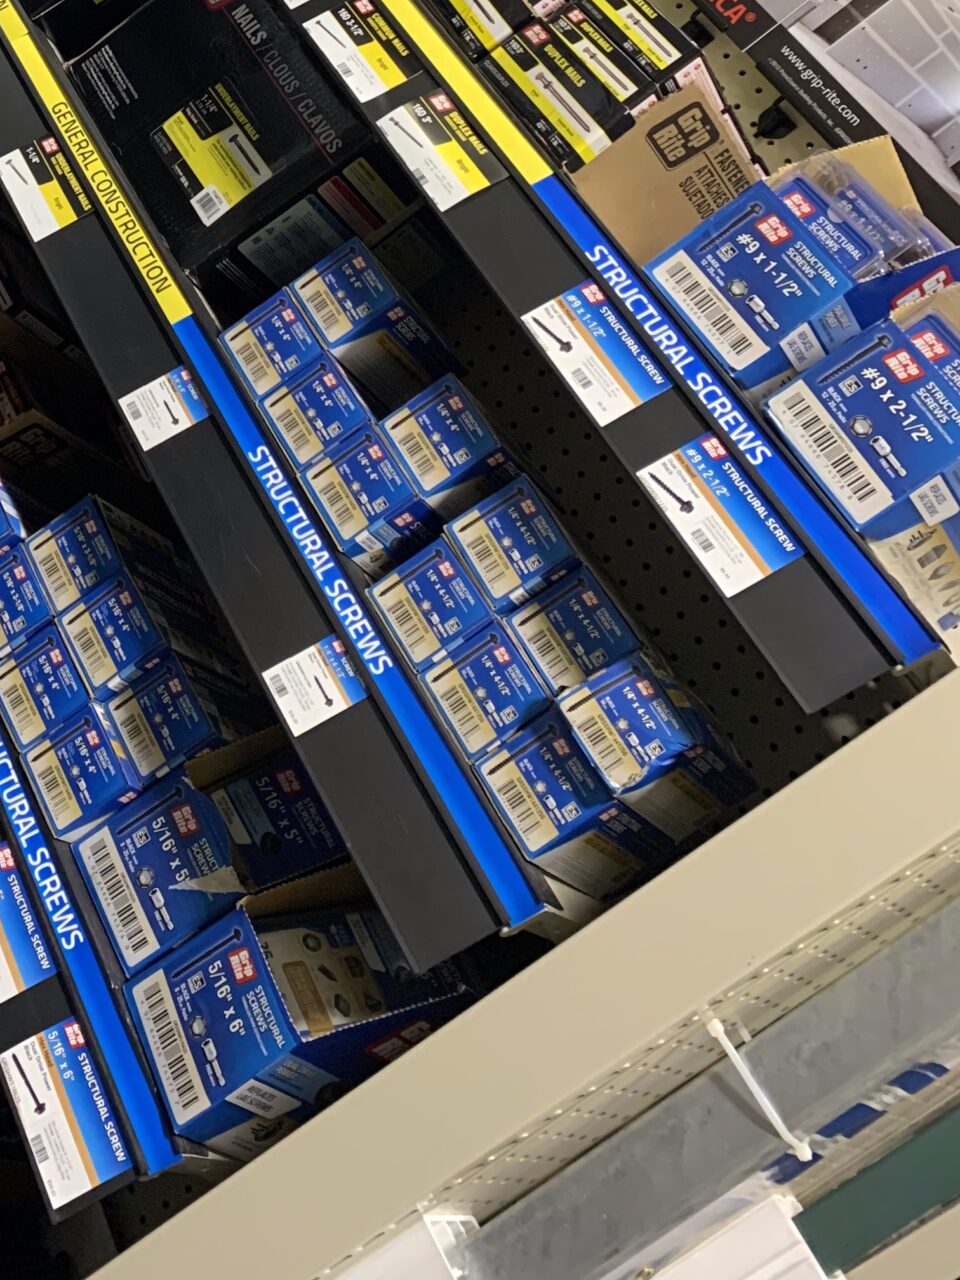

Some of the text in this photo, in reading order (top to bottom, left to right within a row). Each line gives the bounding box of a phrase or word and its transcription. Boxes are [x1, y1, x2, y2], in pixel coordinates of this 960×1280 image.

[370, 11, 410, 58] COMMON NAILS
[229, 2, 344, 156] NAILS / CLOUS / CLAVOS
[780, 44, 861, 128] www.grip-rite.com
[448, 109, 488, 156] DUPLEX NAILS
[652, 124, 687, 163] Rite
[677, 108, 712, 148] Grip
[49, 99, 100, 171] GENERAL
[88, 167, 171, 295] CONSTRUCTION
[694, 164, 731, 209] ATTACHES
[757, 222, 780, 243] Rite
[766, 216, 792, 239] Grip
[735, 233, 804, 297] #9 x 1-1/2"
[786, 247, 817, 279] SCREWS
[794, 241, 838, 288] STRUCTURAL
[583, 240, 773, 469] STRUCTURAL SCREWS
[599, 305, 642, 356] STRUCTURAL
[638, 352, 665, 385] SCREW
[860, 367, 934, 443] #9 x 2-1/2"
[916, 387, 949, 425] SCREWS
[721, 461, 771, 520] STRUCTURAL
[768, 516, 796, 553] SCREW
[245, 442, 393, 677] STRUCTURAL SCREWS
[7, 874, 51, 971] STRUCTURAL SCREW
[25, 845, 85, 952] SCREWS
[207, 959, 246, 1037] 5/16" x 6"
[245, 990, 269, 1033] SCREWS
[254, 984, 286, 1049] STRUCTURAL
[77, 1051, 126, 1163] STRUCTURAL SCREW
